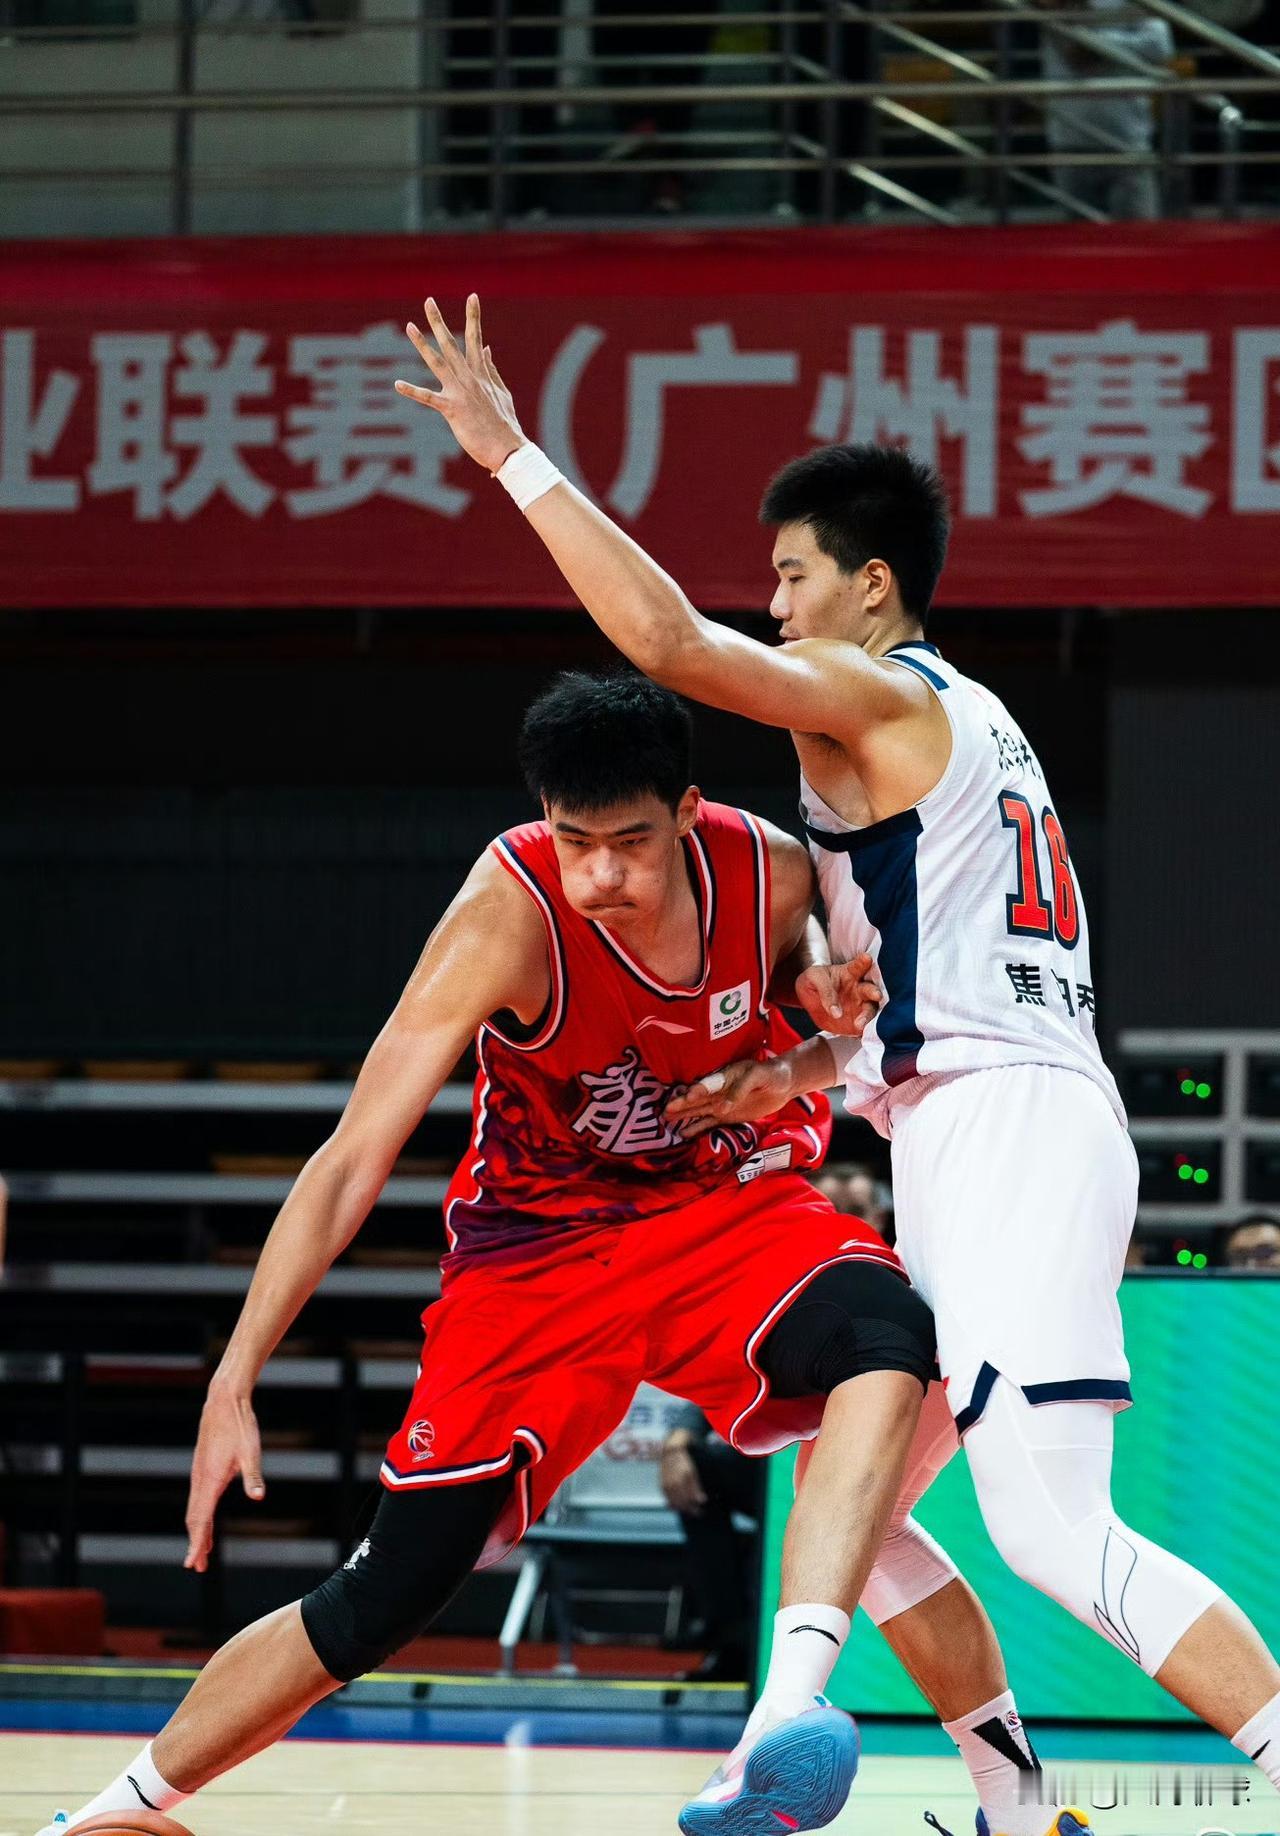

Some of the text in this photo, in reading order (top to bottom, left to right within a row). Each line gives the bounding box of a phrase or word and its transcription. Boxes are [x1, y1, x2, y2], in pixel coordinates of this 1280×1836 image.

[0, 318, 1280, 522] 联赛（广州赛
[998, 789, 1080, 951] 16
